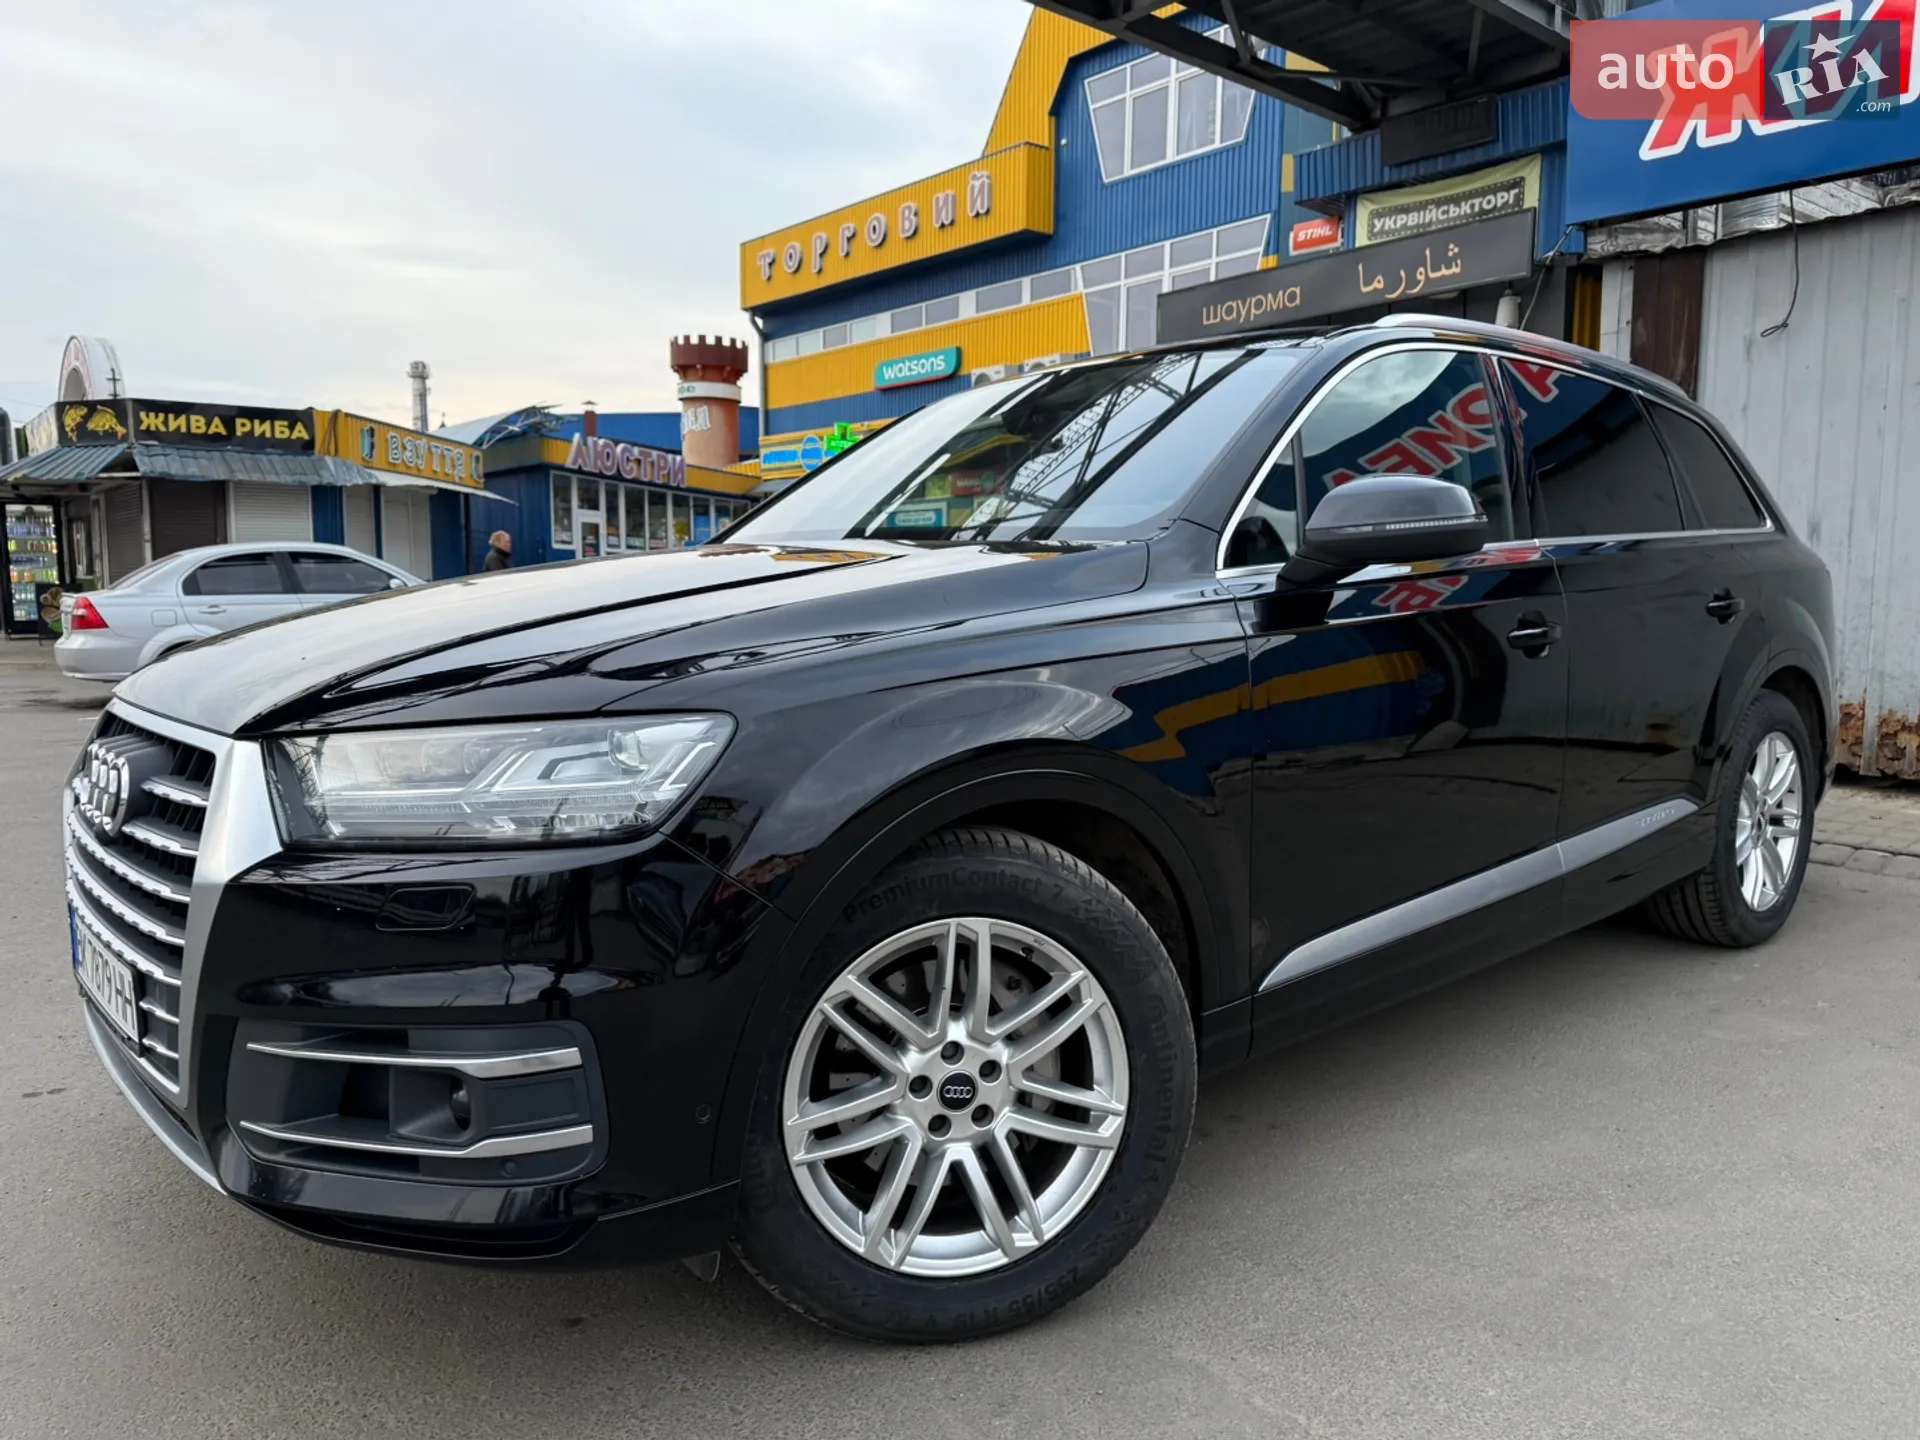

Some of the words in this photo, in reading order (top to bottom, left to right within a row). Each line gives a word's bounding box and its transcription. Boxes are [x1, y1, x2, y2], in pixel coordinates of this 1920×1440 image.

[757, 170, 992, 281] ТОРГОВИЙ
[1297, 226, 1333, 242] STIHL
[1373, 188, 1520, 233] УКРВІЙСЬКТОРГ
[1358, 243, 1462, 299] شاورما
[1202, 285, 1301, 326] шаурма
[882, 354, 946, 380] watsons
[139, 411, 228, 436] ЖИВА
[235, 417, 310, 441] РИБА
[388, 432, 465, 482] ВЗУТТЯ
[564, 432, 687, 488] ЛЮСТРИ
[843, 866, 1042, 923] PremiumContact
[1146, 993, 1179, 1164] Continental
